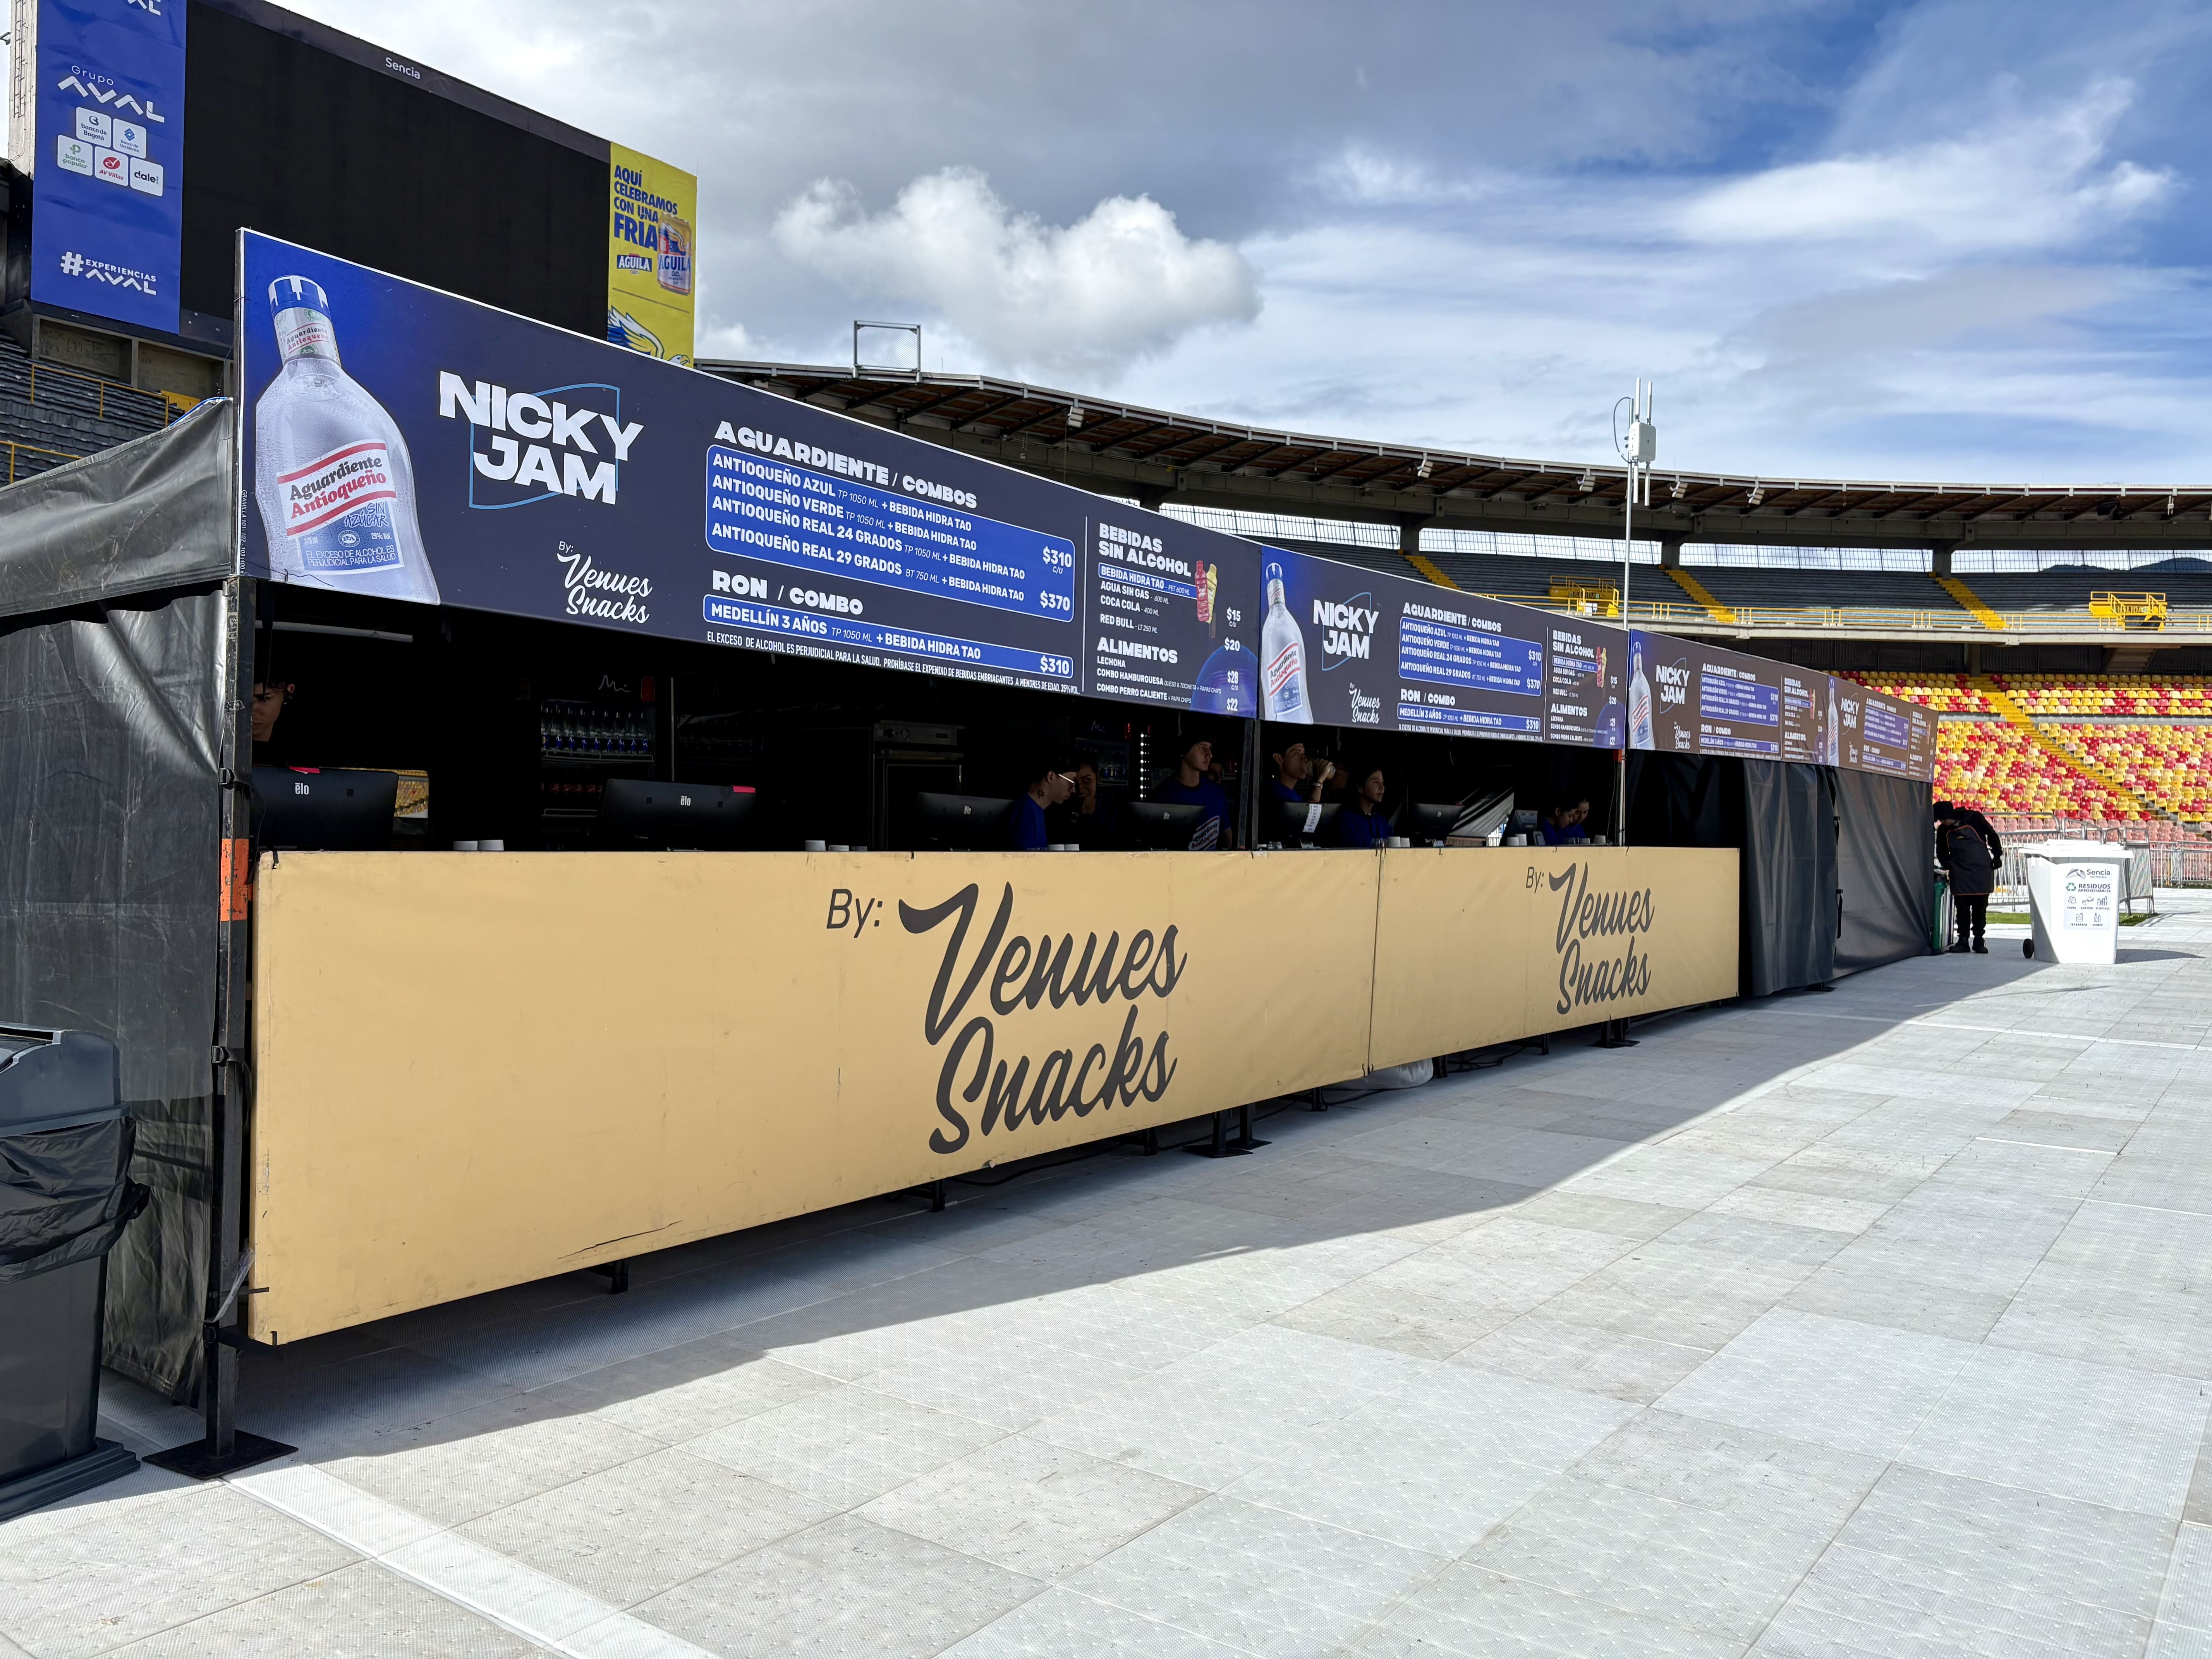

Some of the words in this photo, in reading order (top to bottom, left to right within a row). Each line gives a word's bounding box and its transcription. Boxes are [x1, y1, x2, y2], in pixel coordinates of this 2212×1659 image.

[72, 65, 113, 85] Grupo
[386, 57, 420, 79] Sencia
[57, 76, 165, 123] AVAL
[81, 123, 99, 134] Banco
[83, 130, 104, 141] Bogotá
[65, 154, 85, 163] banco
[120, 143, 139, 153] Occidente
[62, 159, 88, 168] popular
[108, 172, 124, 180] Villas
[134, 171, 158, 184] dale!
[614, 165, 642, 187] AQUÍ
[614, 181, 677, 215] CELEBRAMOS
[614, 197, 634, 216] CON
[637, 204, 658, 223] UNA
[614, 211, 658, 252] FRÍA
[618, 256, 651, 272] AGUILA
[659, 255, 691, 272] AGUILA
[86, 268, 156, 295] AVAL
[440, 371, 644, 461] NICKY
[473, 435, 616, 505] JAM
[714, 421, 888, 485] AGUARDIENTE
[903, 476, 977, 508] COMBOS
[289, 455, 383, 501] Aguardiente
[291, 469, 386, 519] Antioqueño
[713, 453, 800, 487] ANTIOQUEÑO
[803, 477, 835, 496] AZUL
[839, 490, 848, 498] TP
[850, 493, 866, 504] 1050
[869, 498, 878, 508] ML
[890, 501, 924, 519] BEBIDA
[926, 511, 953, 527] HIDRA
[955, 519, 971, 531] TAO
[713, 475, 800, 507] ANTIOQUEÑO
[803, 497, 843, 518] VERDE
[344, 510, 389, 527] AZÚCAR
[367, 501, 386, 515] SIN
[713, 496, 800, 527] ANTIOQUEÑO
[803, 517, 835, 536] REAL
[837, 526, 853, 540] 24
[856, 530, 902, 551] GRADOS
[558, 541, 574, 553] By:
[1099, 523, 1162, 553] BEBIDAS
[307, 558, 350, 567] PERJUDICIAL
[350, 557, 366, 565] PARA
[376, 552, 396, 562] SALUD
[316, 550, 344, 558] EXCESO
[355, 548, 384, 557] ALCOHOL
[387, 545, 395, 553] ES
[712, 523, 799, 553] ANTIOQUEÑO
[803, 543, 835, 561] REAL
[836, 550, 852, 564] 29
[854, 554, 902, 575] GRADOS
[1042, 546, 1072, 568] $310
[1099, 541, 1123, 560] SIN
[1127, 548, 1191, 577] ALCOHOL
[557, 552, 653, 598] Venues
[1052, 565, 1063, 575] C/U
[1101, 566, 1128, 580] BEBIDA
[1129, 573, 1150, 586] HIDRA
[1151, 578, 1164, 589] TAO
[713, 570, 767, 599] RON
[790, 587, 863, 622] COMBO
[1040, 590, 1071, 611] $370
[1101, 581, 1121, 593] AGUA
[1122, 586, 1133, 596] SIN
[1135, 589, 1149, 599] GAS
[566, 584, 650, 624] Snacks
[1101, 595, 1120, 608] COCA
[1121, 599, 1140, 611] COLA
[712, 603, 778, 627] MEDELLÍN
[782, 615, 790, 628] 3
[792, 616, 827, 634] AÑOS
[1100, 613, 1115, 625] RED
[1116, 617, 1134, 629] BULL
[1226, 607, 1241, 622] $15
[1313, 599, 1379, 634] NICKY
[1403, 602, 1467, 626] AGUARDIENTE
[1472, 618, 1502, 632] COMBOS
[1224, 637, 1240, 652] $20
[1323, 630, 1369, 660] JAM
[1553, 630, 1582, 645] BEBIDAS
[708, 631, 715, 642] EL
[717, 633, 742, 646] EXCESO
[746, 637, 754, 647] DE
[756, 639, 785, 652] ALCOHOL
[787, 643, 794, 654] ES
[796, 645, 834, 659] PERJUDICIAL
[835, 651, 851, 662] PARA
[853, 654, 860, 663] LA
[861, 655, 881, 666] SALUD.
[884, 658, 914, 671] PROHÍBASE
[915, 663, 921, 672] EL
[922, 664, 947, 675] EXPENDIO
[948, 668, 955, 677] DE
[955, 669, 977, 680] BEBIDAS
[977, 672, 1013, 685] EMBRIAGANTES
[1015, 678, 1019, 686] A
[1020, 678, 1041, 689] MENORES
[1041, 682, 1047, 690] DE
[1097, 637, 1177, 663] ALIMENTOS
[1528, 649, 1541, 662] $310
[1553, 641, 1564, 653] SIN
[1565, 646, 1595, 659] ALCOHOL
[1040, 655, 1070, 675] $310
[1097, 656, 1125, 668] LECHONA
[1702, 663, 1737, 678] AGUARDIENTE
[1097, 668, 1118, 678] COMBO
[1120, 672, 1163, 685] HAMBURGUESA
[1228, 670, 1238, 684] $28
[1656, 665, 1690, 687] NICKY
[1097, 683, 1118, 693] COMBO
[1120, 687, 1139, 696] PERRO
[1140, 689, 1167, 700] CALIENTE
[1349, 688, 1381, 709] Venues
[1401, 689, 1420, 702] RON
[1428, 693, 1456, 706] COMBO
[1661, 685, 1685, 704] JAM
[1226, 698, 1238, 712] $22
[1352, 706, 1380, 724] Snacks
[1551, 703, 1587, 717] ALIMENTOS
[1841, 697, 1860, 716] NICKY
[1843, 713, 1856, 729] JAM
[1526, 867, 1543, 893] By:
[826, 889, 883, 939] By:
[1549, 862, 1655, 954] Venues
[898, 881, 1187, 1045] Venues
[1556, 936, 1652, 1015] Snacks
[929, 1004, 1178, 1154] Snacks
